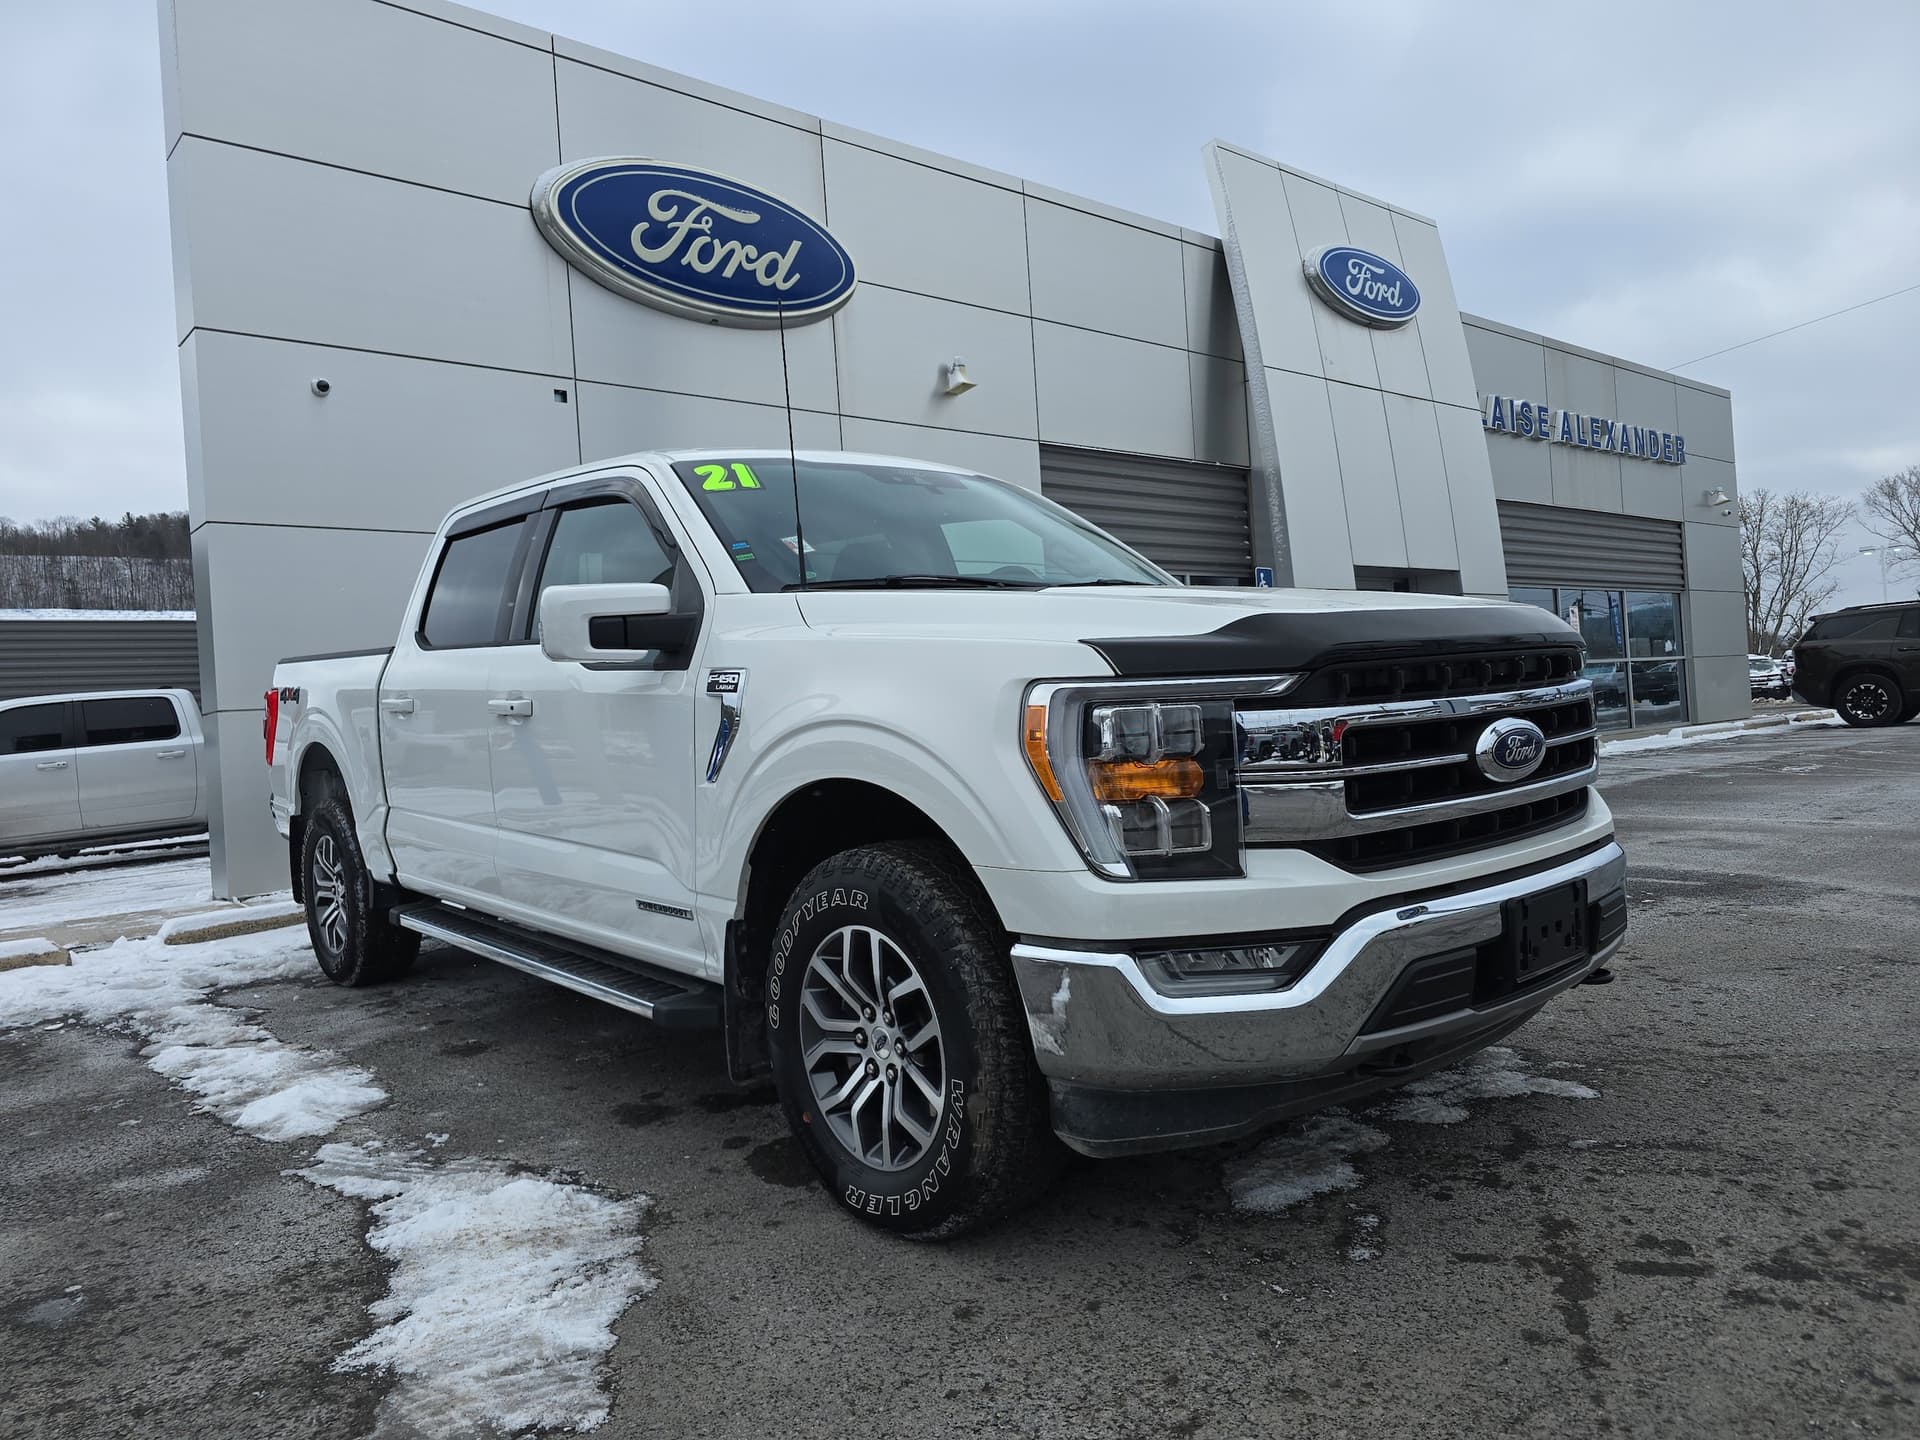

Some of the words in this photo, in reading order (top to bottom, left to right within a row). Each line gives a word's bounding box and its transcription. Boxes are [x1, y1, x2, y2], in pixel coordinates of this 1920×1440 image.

[631, 189, 803, 291] Ford
[1346, 258, 1403, 307] Ford
[1482, 395, 1550, 438] AISE
[1556, 411, 1687, 464] ALEXANDER
[694, 463, 761, 491] 21
[1505, 734, 1537, 763] Ford
[768, 888, 869, 1030] GOODYEAR
[845, 1079, 965, 1216] WRANGLER
